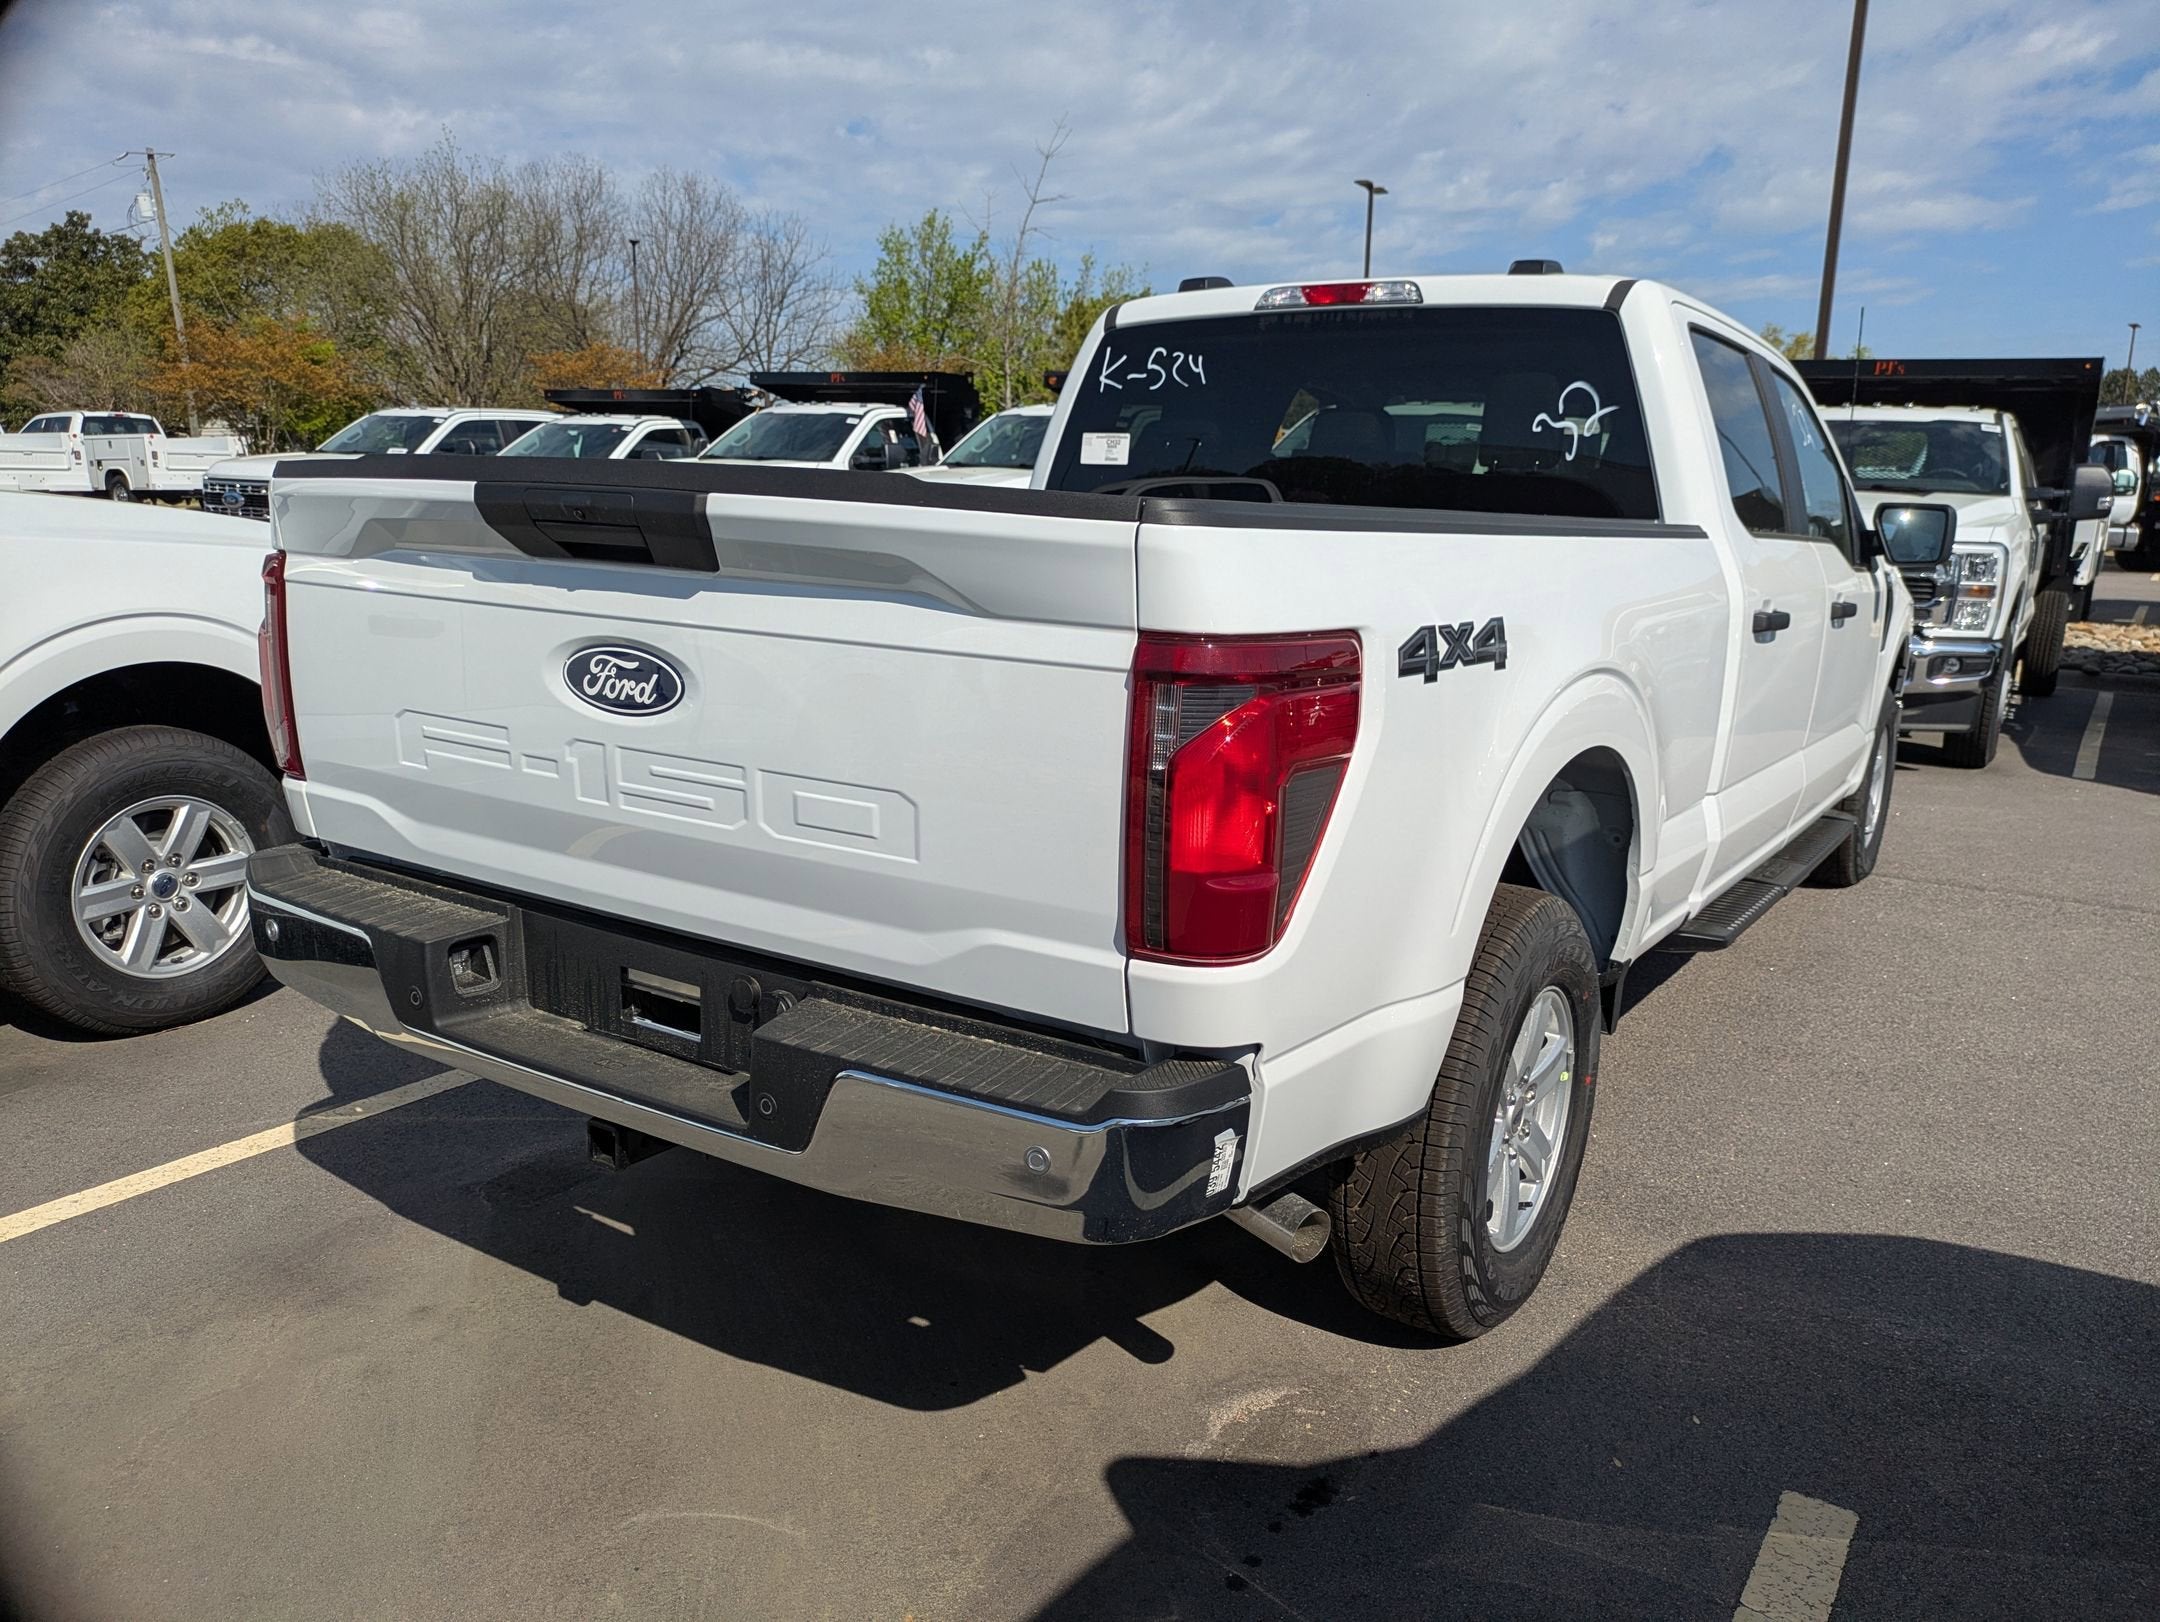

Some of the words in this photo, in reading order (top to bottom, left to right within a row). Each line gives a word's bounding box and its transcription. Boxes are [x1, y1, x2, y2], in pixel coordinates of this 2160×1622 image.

[1099, 346, 1206, 393] K-524
[583, 655, 658, 704] Ford
[394, 709, 919, 863] F-150
